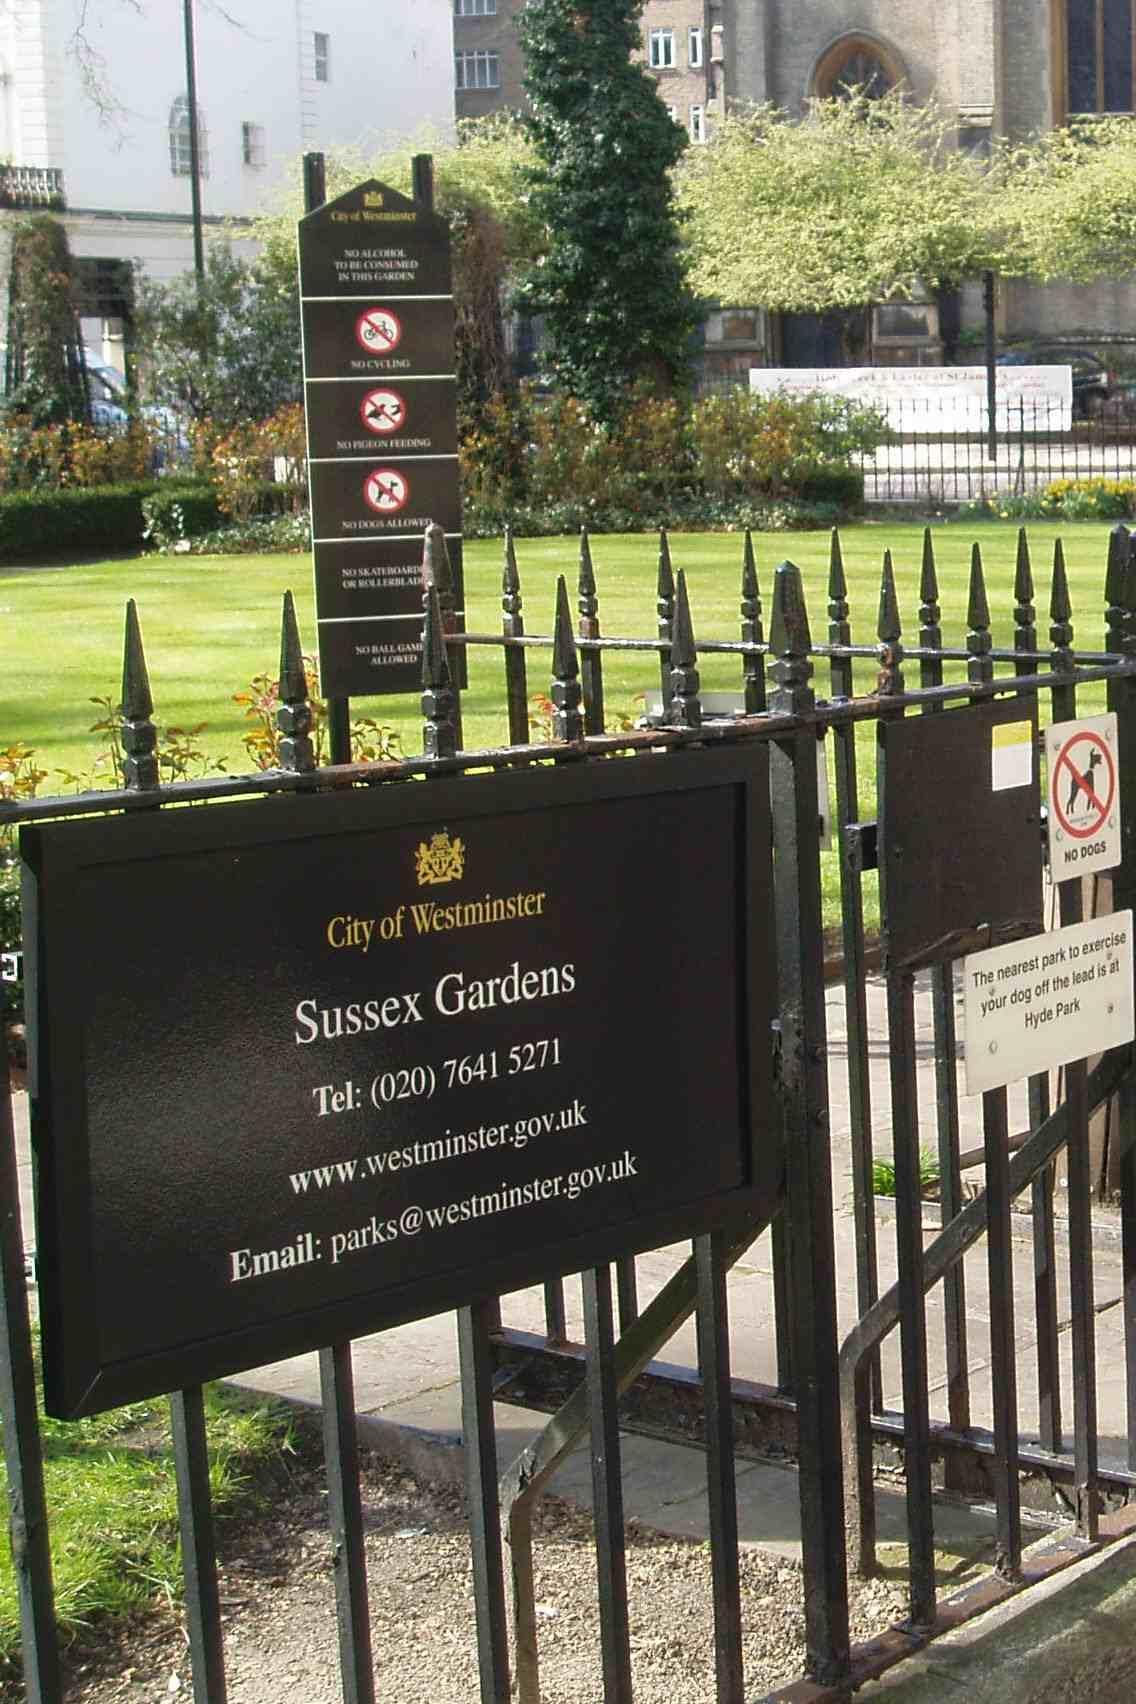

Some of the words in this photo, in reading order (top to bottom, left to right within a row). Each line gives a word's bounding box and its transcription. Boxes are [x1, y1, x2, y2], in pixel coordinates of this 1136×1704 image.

[331, 211, 350, 223] City
[351, 211, 361, 221] of
[362, 211, 417, 221] Westminster
[344, 249, 359, 258] NO
[361, 248, 407, 258] ALCOHOL
[335, 261, 348, 270] TO
[349, 260, 361, 270] BE
[363, 260, 419, 270] CONSUMED
[338, 272, 350, 281] IN
[351, 272, 373, 281] THIS
[374, 271, 416, 281] GARDEN
[351, 360, 366, 370] NO
[367, 358, 411, 370] CYCLING
[337, 440, 352, 449] NO
[353, 439, 388, 449] PIGEON
[390, 438, 431, 448] FEEDING
[342, 520, 358, 529] NO
[358, 519, 385, 529] DOGS
[385, 517, 434, 528] ALLOWED
[342, 568, 357, 577] NO
[342, 579, 356, 588] OR
[355, 645, 370, 655] NO
[371, 644, 396, 654] BALL
[397, 642, 423, 653] GAME
[370, 654, 417, 665] ALLOWED
[1064, 847, 1079, 863] NO
[1080, 841, 1107, 859] DOGS
[327, 915, 373, 952] City
[380, 907, 405, 941] of
[411, 889, 546, 933] Westminster
[973, 968, 995, 988] The
[996, 959, 1040, 979] nearest
[1042, 951, 1068, 972] park
[1068, 946, 1080, 962] to
[1082, 934, 1127, 952] exercise
[981, 994, 1007, 1017] your
[1010, 984, 1033, 1006] dog
[1034, 977, 1051, 997] off
[1052, 972, 1070, 991] the
[1072, 966, 1095, 986] lead
[1097, 964, 1107, 979] is
[1109, 961, 1121, 976] at
[295, 991, 424, 1045] Sussex
[435, 961, 577, 1017] Gardens
[1024, 1006, 1054, 1028] Hyde
[1056, 998, 1081, 1019] Park
[313, 1082, 362, 1116] Tel:
[370, 1066, 437, 1110] (020)
[443, 1050, 500, 1088] 7641
[509, 1038, 562, 1073] 5271
[288, 1099, 588, 1195] www.westminster.gov.uk
[230, 1235, 323, 1282] Email:
[331, 1151, 638, 1264] parks@westminster.gov.uk
